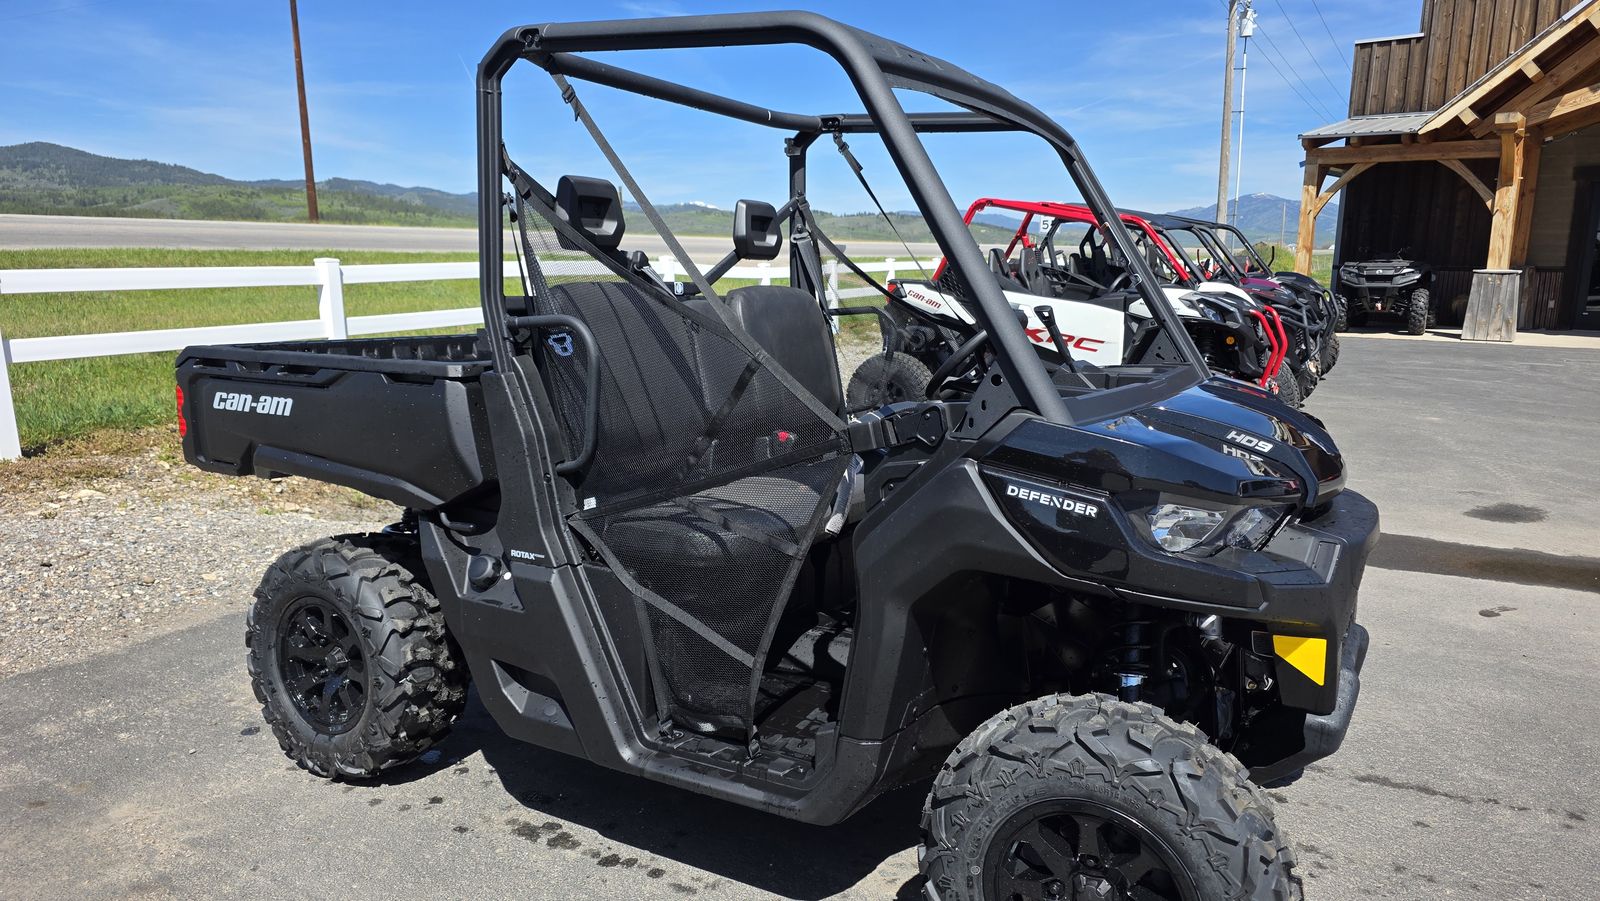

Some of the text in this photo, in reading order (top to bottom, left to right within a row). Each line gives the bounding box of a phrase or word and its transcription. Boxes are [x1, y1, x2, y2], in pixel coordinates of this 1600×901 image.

[907, 289, 942, 309] can-am
[213, 391, 293, 417] can-am
[1226, 430, 1274, 453] HD9
[1006, 485, 1098, 518] DEFENDER
[510, 549, 536, 561] ROTAX
